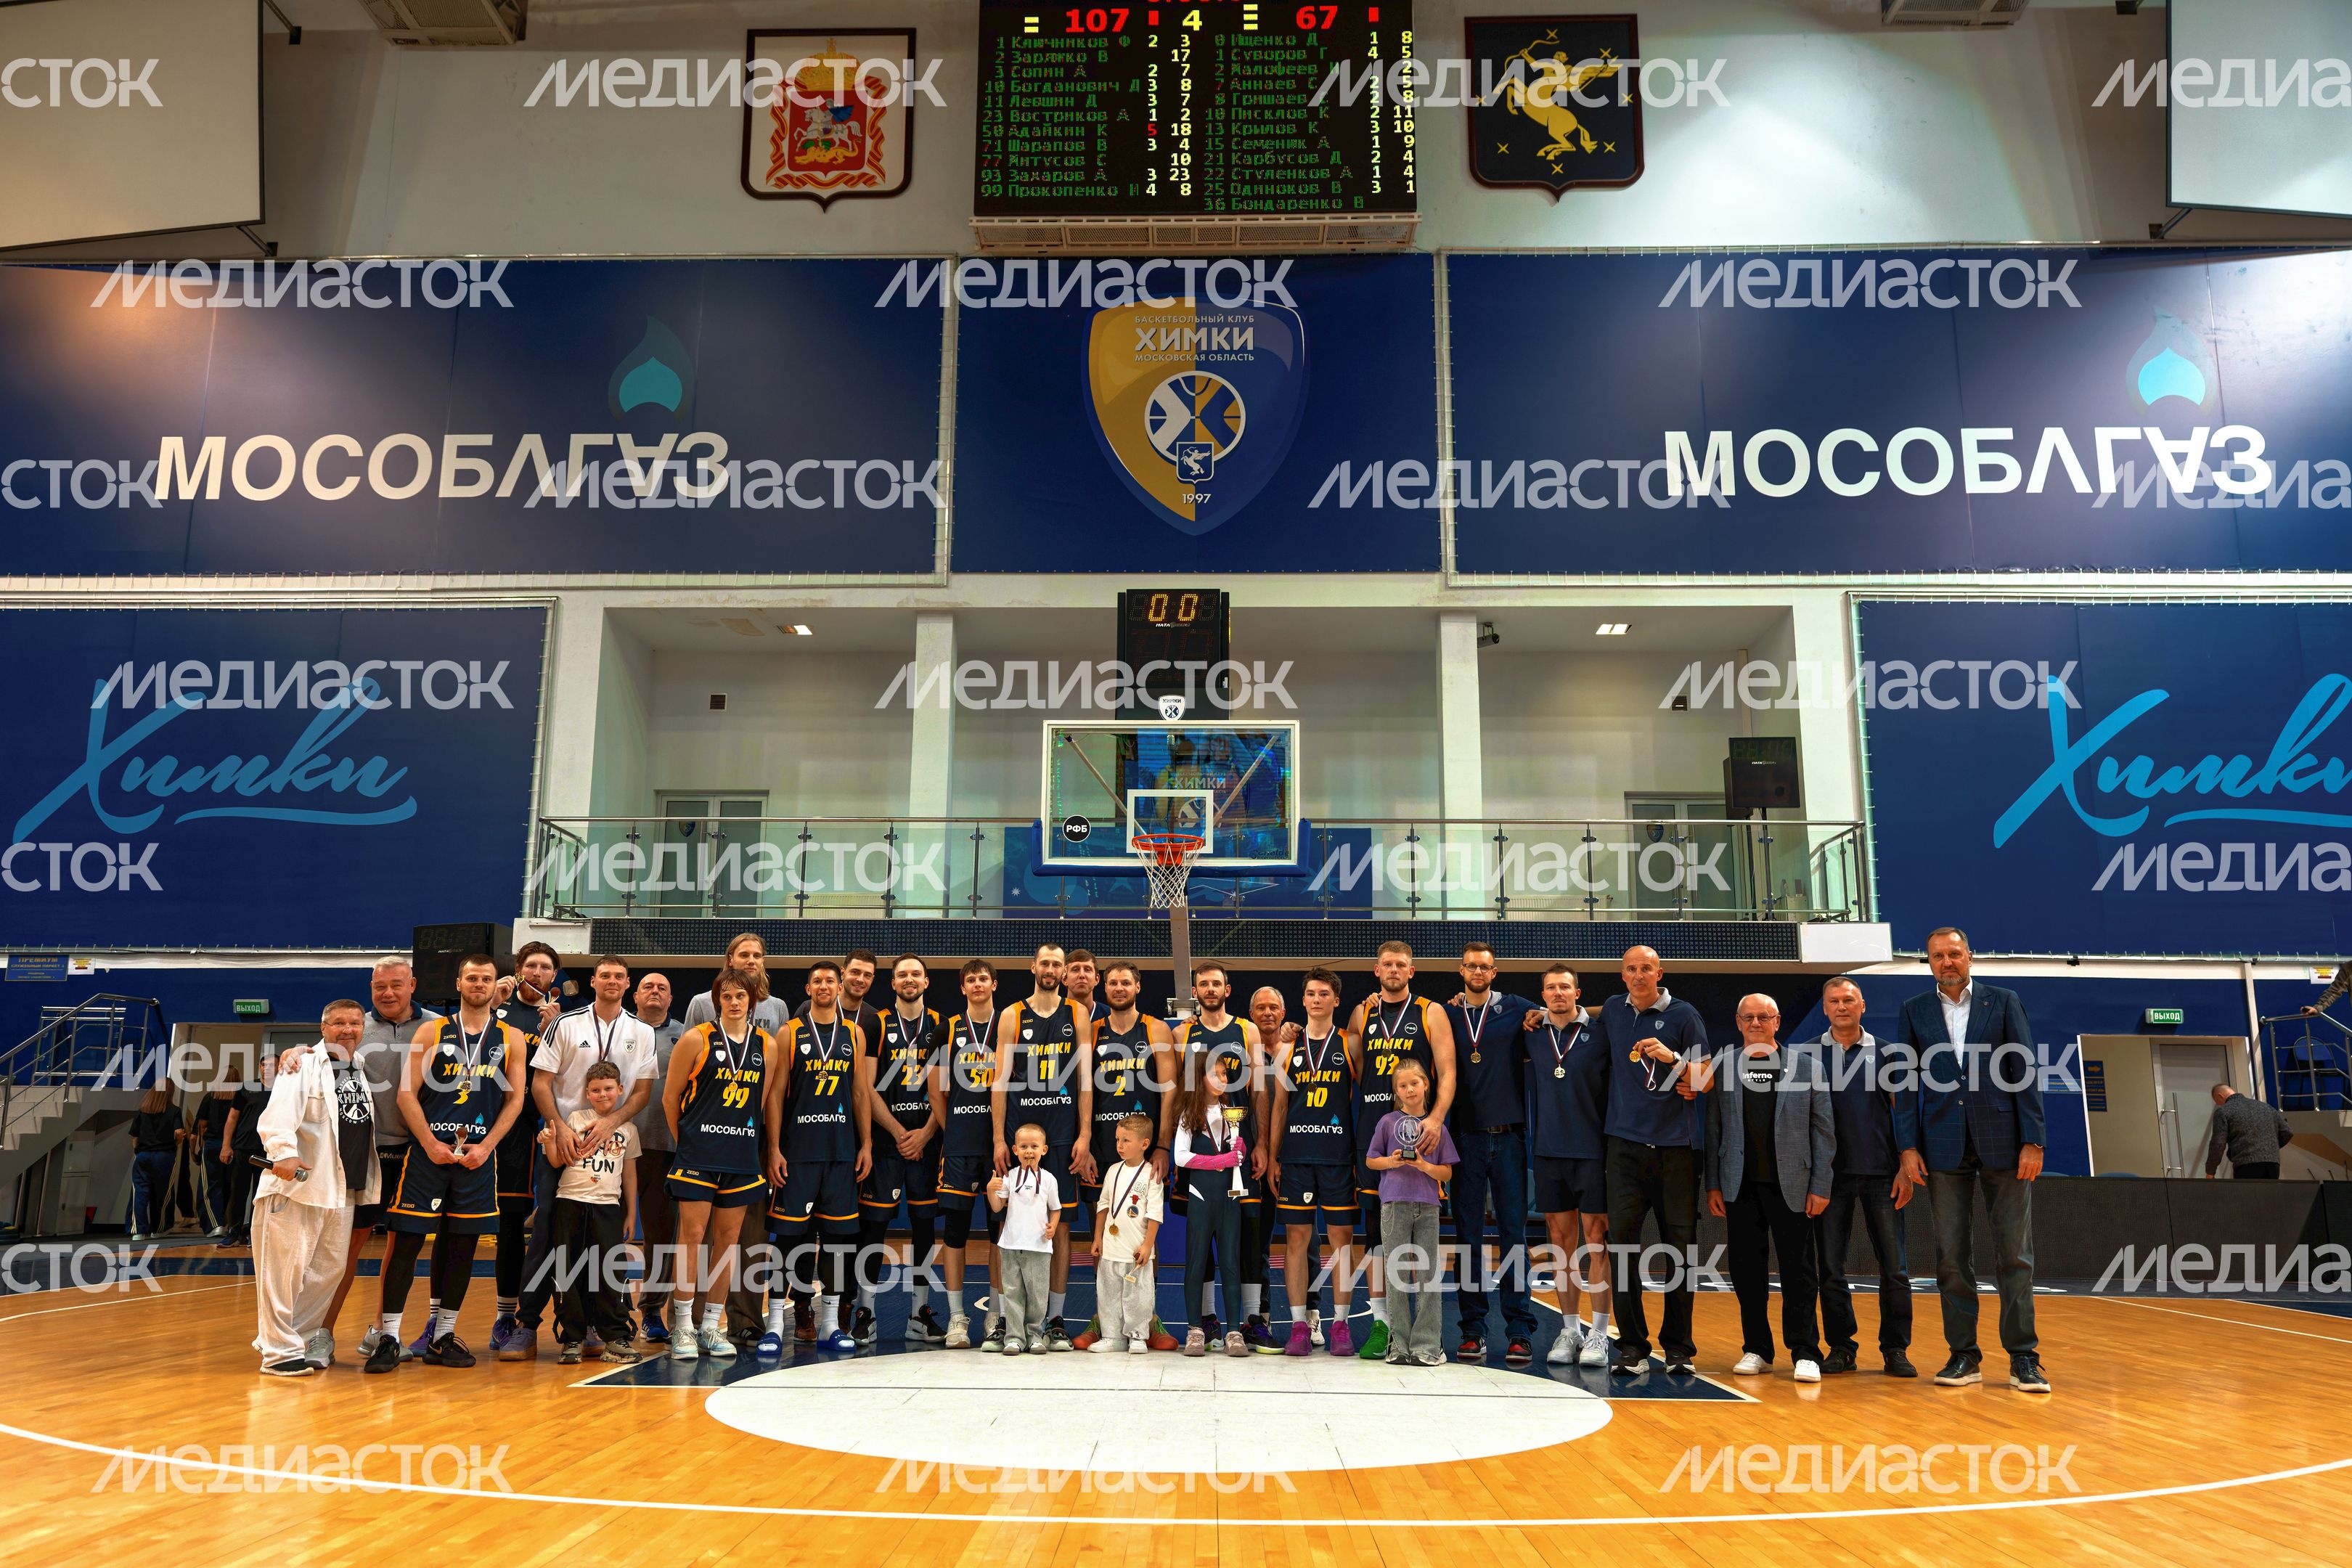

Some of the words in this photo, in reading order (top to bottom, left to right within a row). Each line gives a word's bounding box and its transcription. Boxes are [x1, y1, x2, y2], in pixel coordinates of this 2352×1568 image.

[1066, 9, 1130, 33] 107
[1182, 10, 1202, 30] 4
[1296, 6, 1338, 29] 67
[1148, 35, 1157, 47] 2
[1181, 35, 1190, 47] 3
[1371, 31, 1378, 44] 1
[1402, 30, 1413, 44] 8
[1172, 49, 1190, 62] 17
[1232, 49, 1307, 62] Суворов
[1368, 46, 1378, 59] 4
[1402, 46, 1413, 60] 5
[1012, 66, 1063, 77] Сопин
[1148, 64, 1157, 77] 2
[1181, 64, 1190, 76] 7
[1402, 61, 1411, 73] 2
[1011, 81, 1119, 93] Богданович
[1148, 79, 1157, 91] 3
[1181, 78, 1191, 91] 8
[1370, 76, 1379, 89] 2
[1402, 75, 1411, 88] 5
[1010, 95, 1074, 107] Левшин
[1148, 94, 1157, 106] 3
[1181, 94, 1190, 106] 7
[1371, 91, 1379, 103] 2
[1402, 91, 1413, 103] 8
[1010, 110, 1107, 122] Востриков
[1149, 108, 1157, 121] 1
[1181, 108, 1190, 121] 2
[1371, 106, 1379, 118] 2
[1394, 106, 1413, 118] 11
[1009, 123, 1084, 137] Адайкин
[1148, 123, 1157, 136] 5
[1172, 123, 1191, 136] 18
[1232, 123, 1297, 135] Крылов
[1371, 121, 1380, 133] 3
[1395, 120, 1416, 133] 10
[1008, 139, 1085, 152] Шарапов
[1148, 139, 1156, 151] 3
[1180, 138, 1190, 150] 4
[1372, 136, 1380, 148] 1
[1404, 135, 1416, 147] 9
[1171, 153, 1191, 166] 10
[1371, 150, 1380, 163] 2
[1403, 150, 1413, 163] 4
[1010, 170, 1085, 182] Захаров
[1148, 168, 1156, 181] 3
[1169, 168, 1190, 181] 23
[1373, 166, 1381, 178] 1
[1404, 165, 1414, 178] 4
[1009, 184, 1118, 197] Прокопенко
[1146, 184, 1156, 196] 4
[1180, 183, 1191, 196] 8
[1372, 181, 1381, 193] 3
[1407, 180, 1414, 193] 1
[1232, 198, 1342, 211] Бондаренко
[1135, 314, 1224, 323] БАСКЕТБОЛЬНЫЙ
[1135, 327, 1254, 351] ХИМКИ
[1135, 353, 1206, 362] МОСКОВСКАЯ
[1209, 353, 1254, 362] ОБЛАСТЬ
[1182, 493, 1212, 504] 1997
[12, 677, 417, 844] Химки
[1066, 823, 1087, 833] РФБ
[236, 1005, 261, 1013] ВЫХОД
[2154, 1011, 2181, 1021] ВЫХОД
[1027, 1042, 1071, 1057] ХИМКИ
[1367, 1038, 1413, 1051] ХИМКИ
[958, 1052, 996, 1064] ХИМК
[1100, 1058, 1146, 1072] ХИМКИ
[1040, 1060, 1055, 1079] 11
[969, 1068, 995, 1088] 50
[1114, 1076, 1126, 1096] 2
[337, 1092, 369, 1103] KHIM
[722, 1086, 750, 1108] 99
[1307, 1087, 1328, 1108] 10
[582, 1157, 615, 1174] FUN
